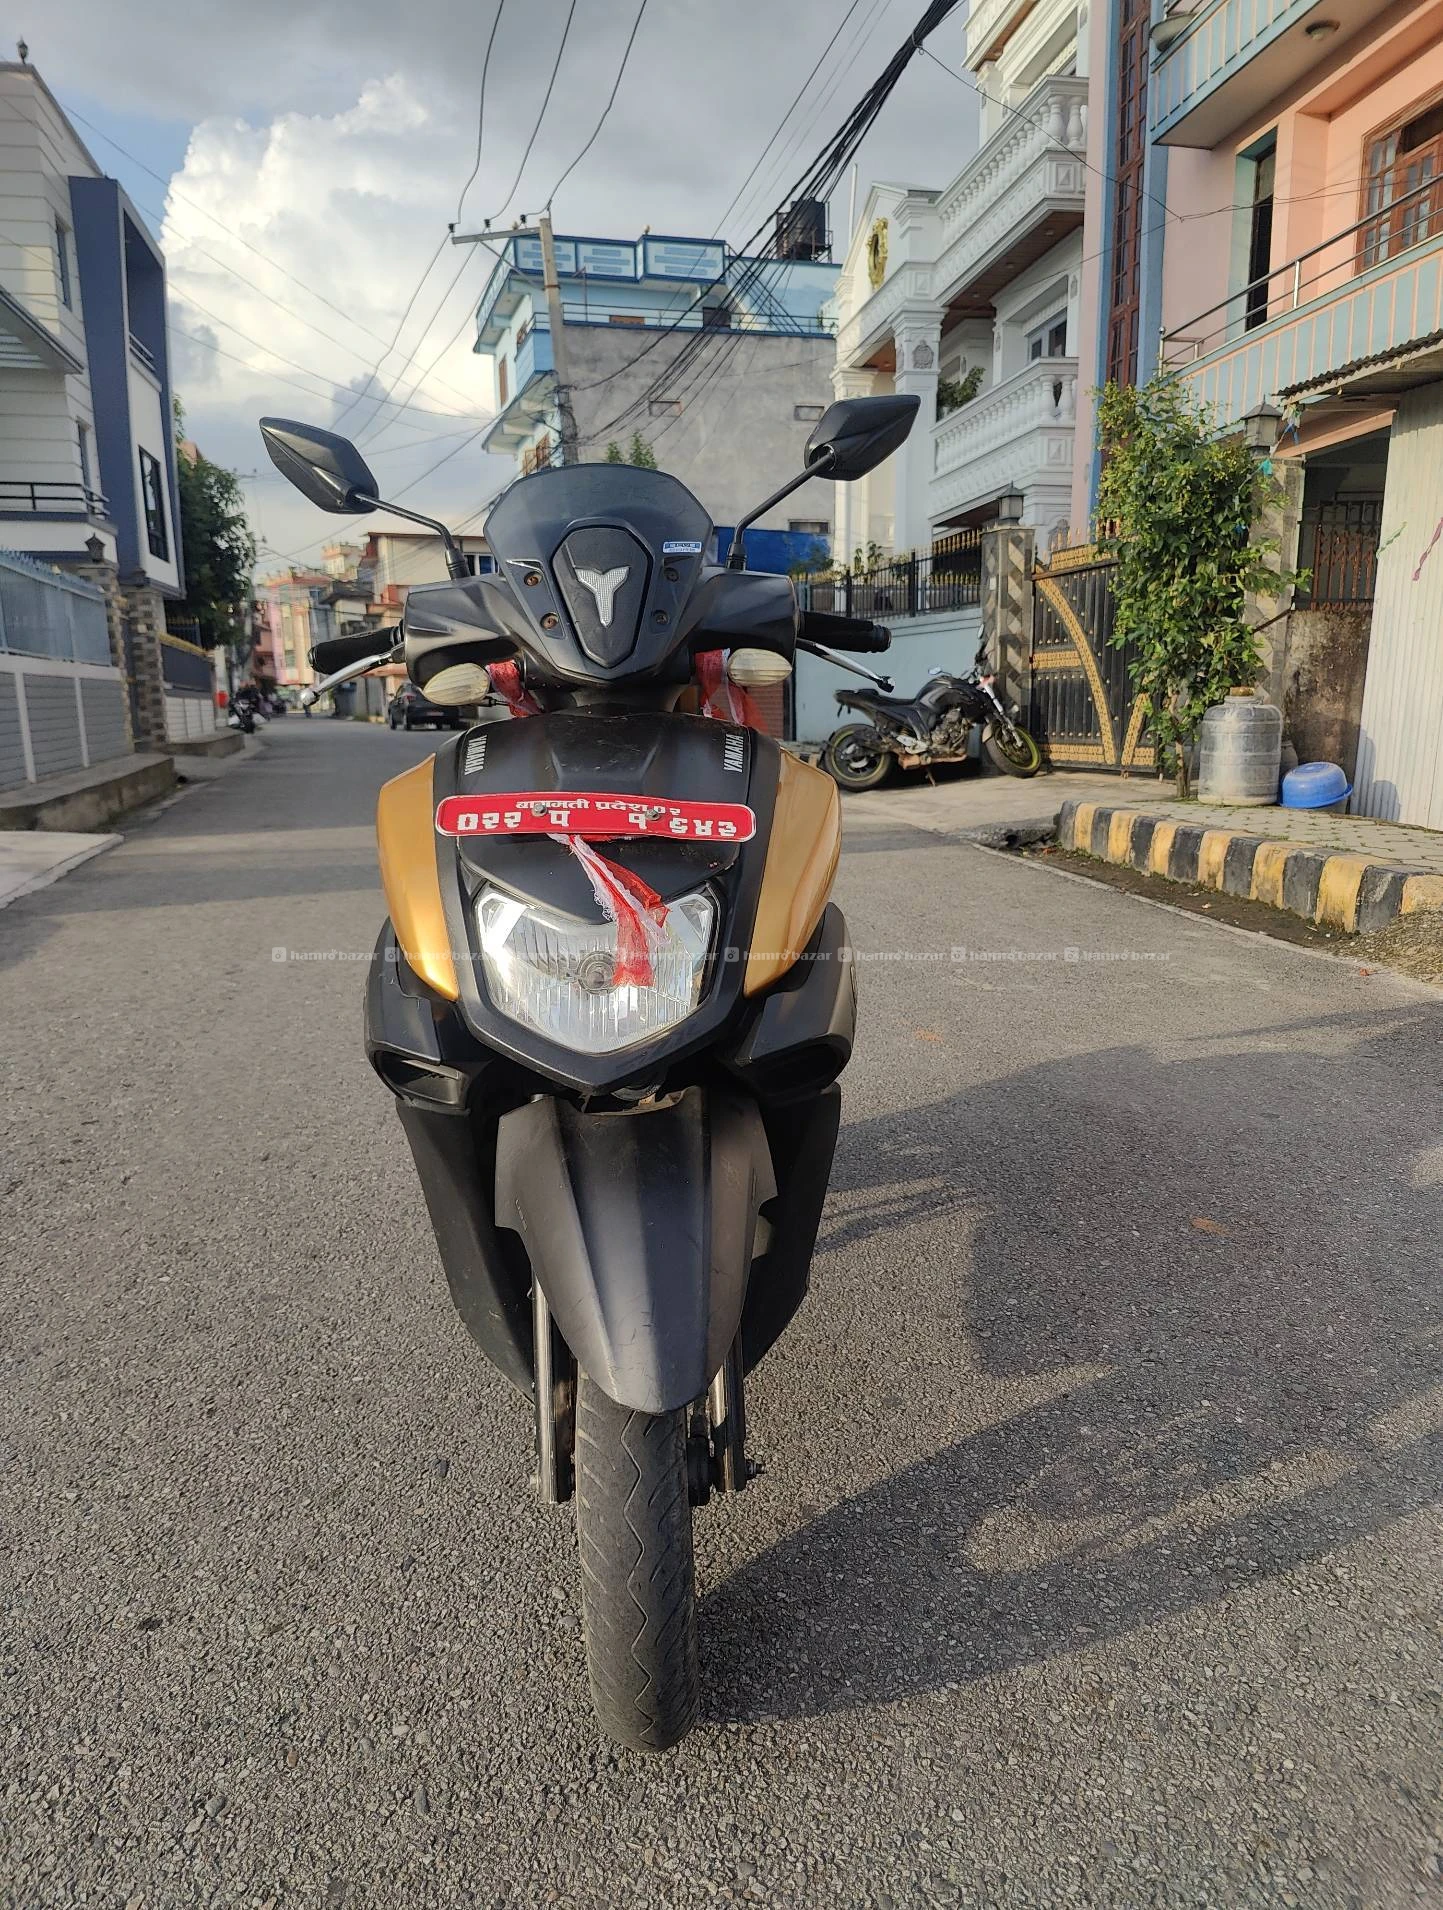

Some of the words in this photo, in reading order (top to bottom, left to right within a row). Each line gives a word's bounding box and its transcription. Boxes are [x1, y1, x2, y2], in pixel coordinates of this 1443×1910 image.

[464, 734, 488, 776] YAMAHA
[723, 733, 744, 773] YAMAHA
[457, 811, 522, 831] ०२२
[548, 809, 571, 827] प
